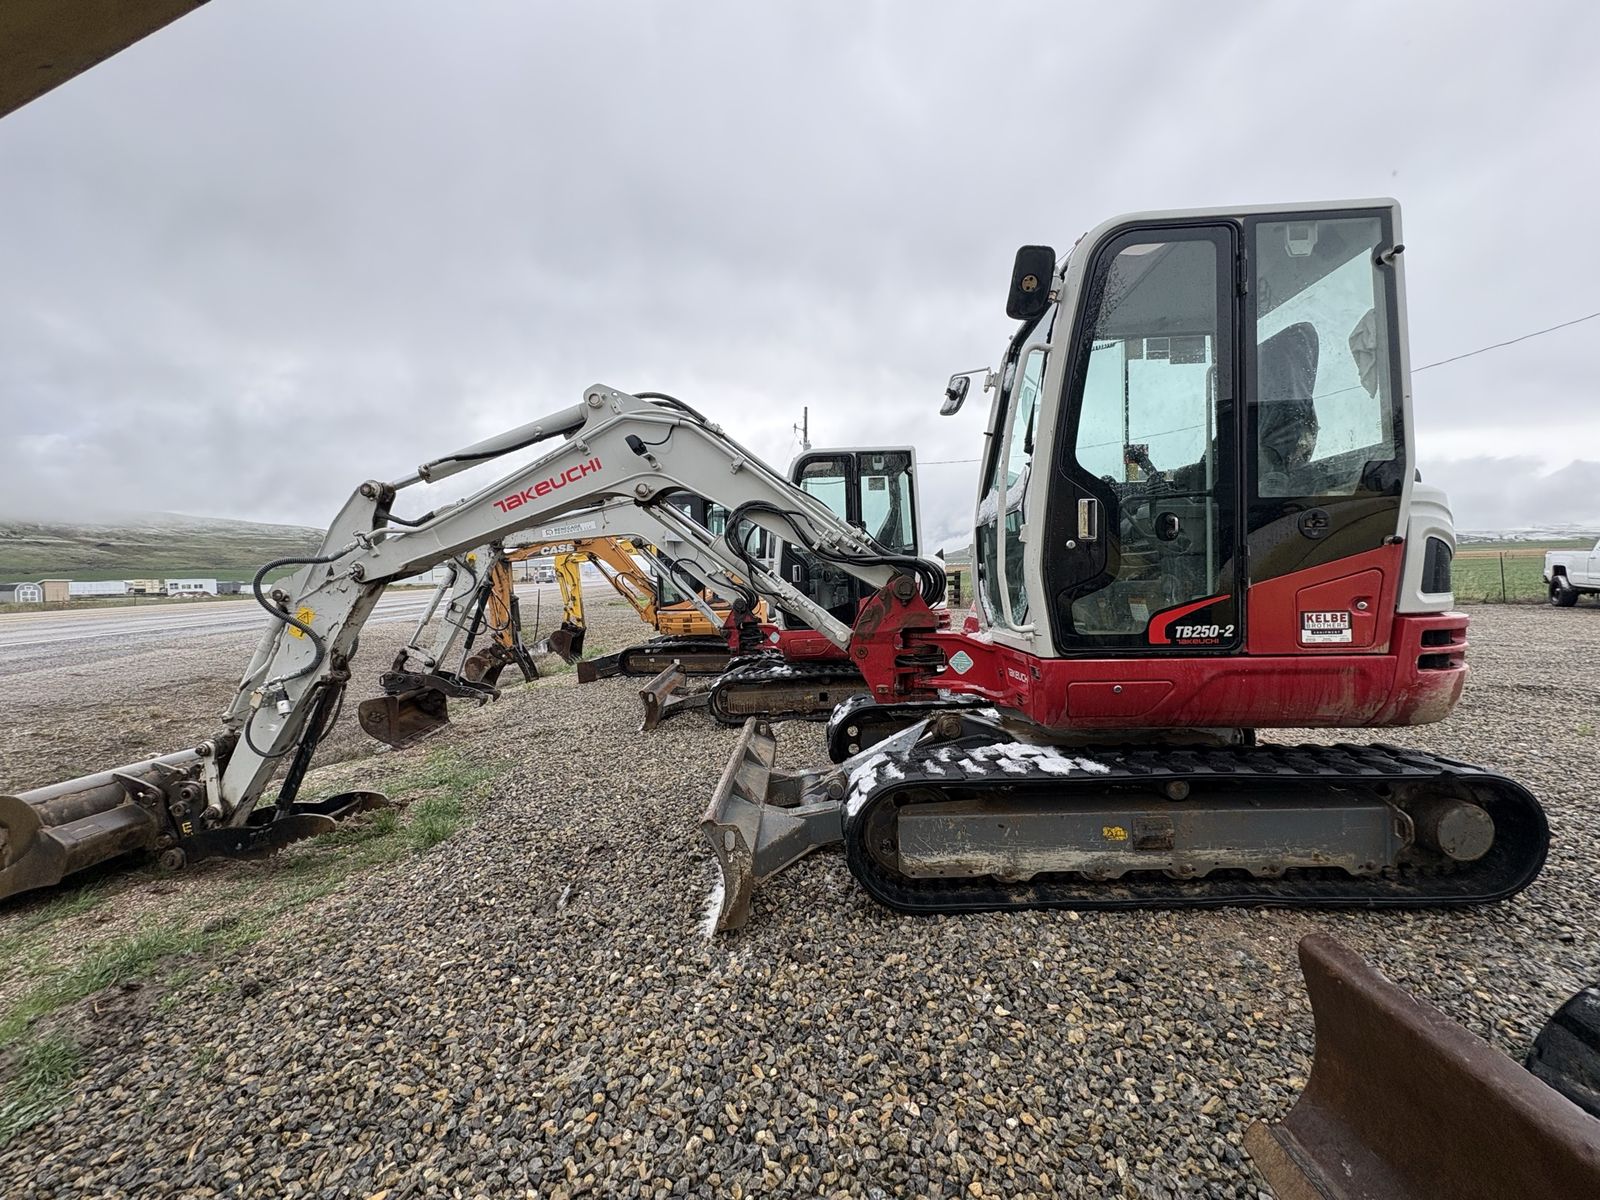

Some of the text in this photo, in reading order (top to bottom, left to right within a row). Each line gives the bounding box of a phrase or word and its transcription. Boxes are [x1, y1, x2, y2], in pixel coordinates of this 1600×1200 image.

[493, 457, 603, 513] TAKEUCHI
[541, 543, 576, 555] CASE
[1306, 613, 1347, 623] KELBE
[1175, 624, 1235, 638] TB250-2
